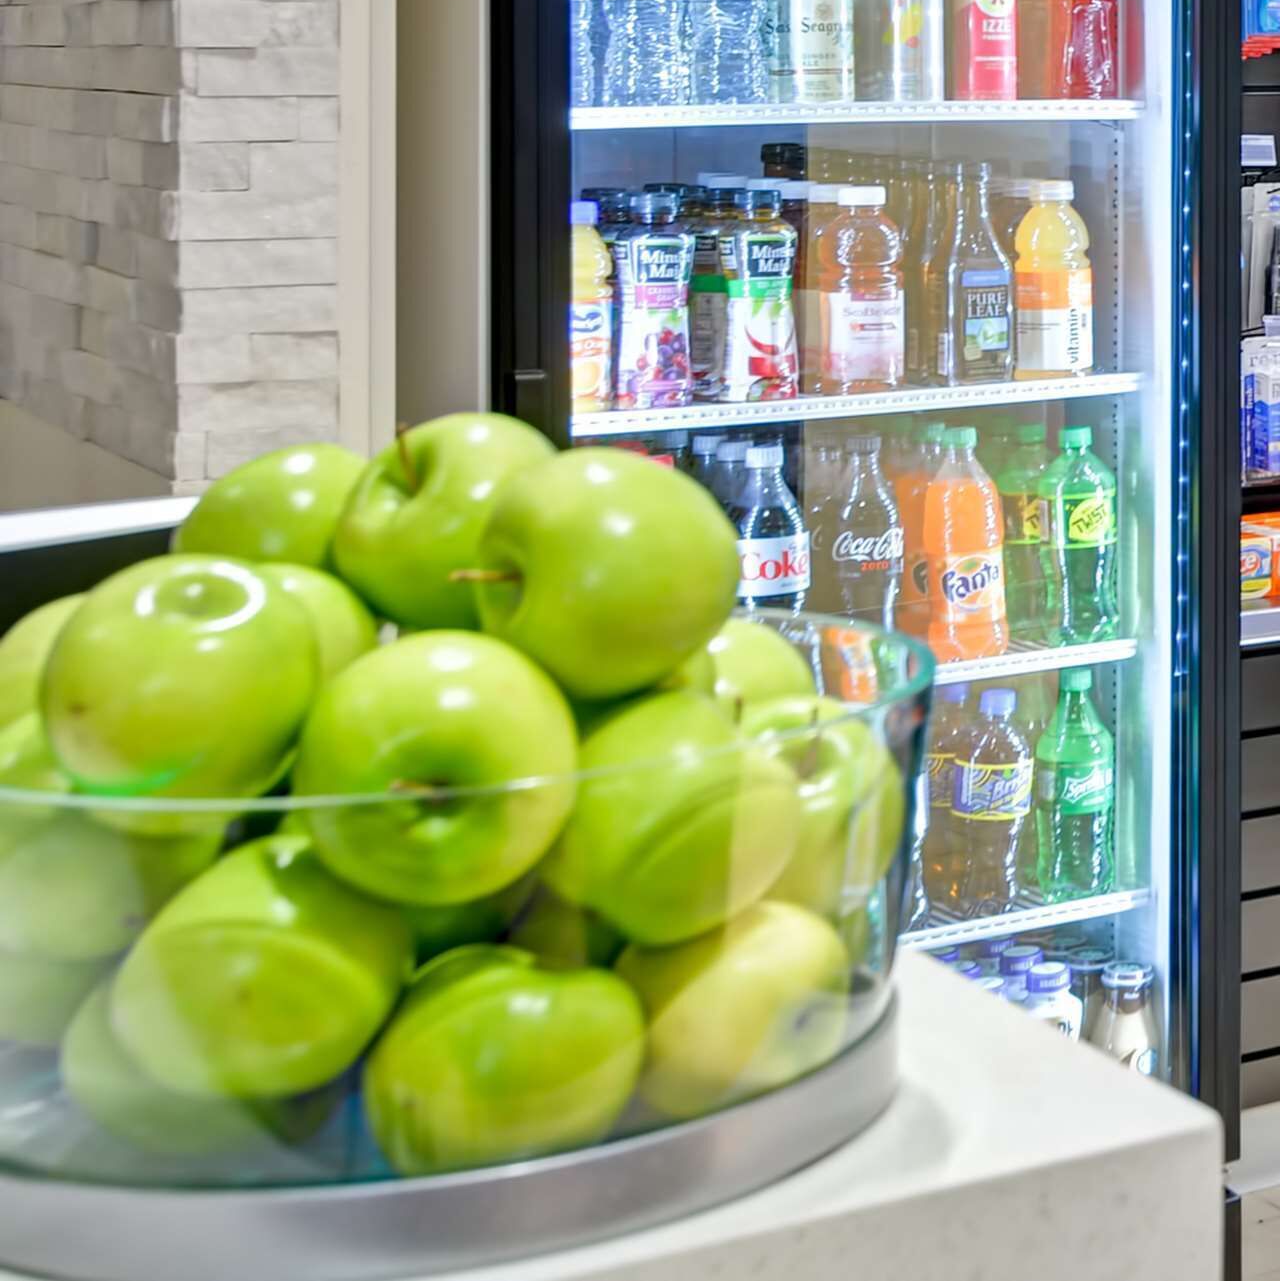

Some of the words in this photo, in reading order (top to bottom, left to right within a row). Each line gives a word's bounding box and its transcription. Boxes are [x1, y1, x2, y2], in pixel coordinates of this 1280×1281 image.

[642, 249, 690, 266] Minu
[751, 244, 795, 260] Minu
[966, 291, 1008, 306] PURE
[966, 304, 1005, 320] LEAF
[1066, 307, 1080, 364] vitamin
[741, 542, 810, 581] Coke
[860, 560, 889, 573] zero
[942, 557, 1001, 605] Fanta
[1066, 770, 1113, 803] Spri
